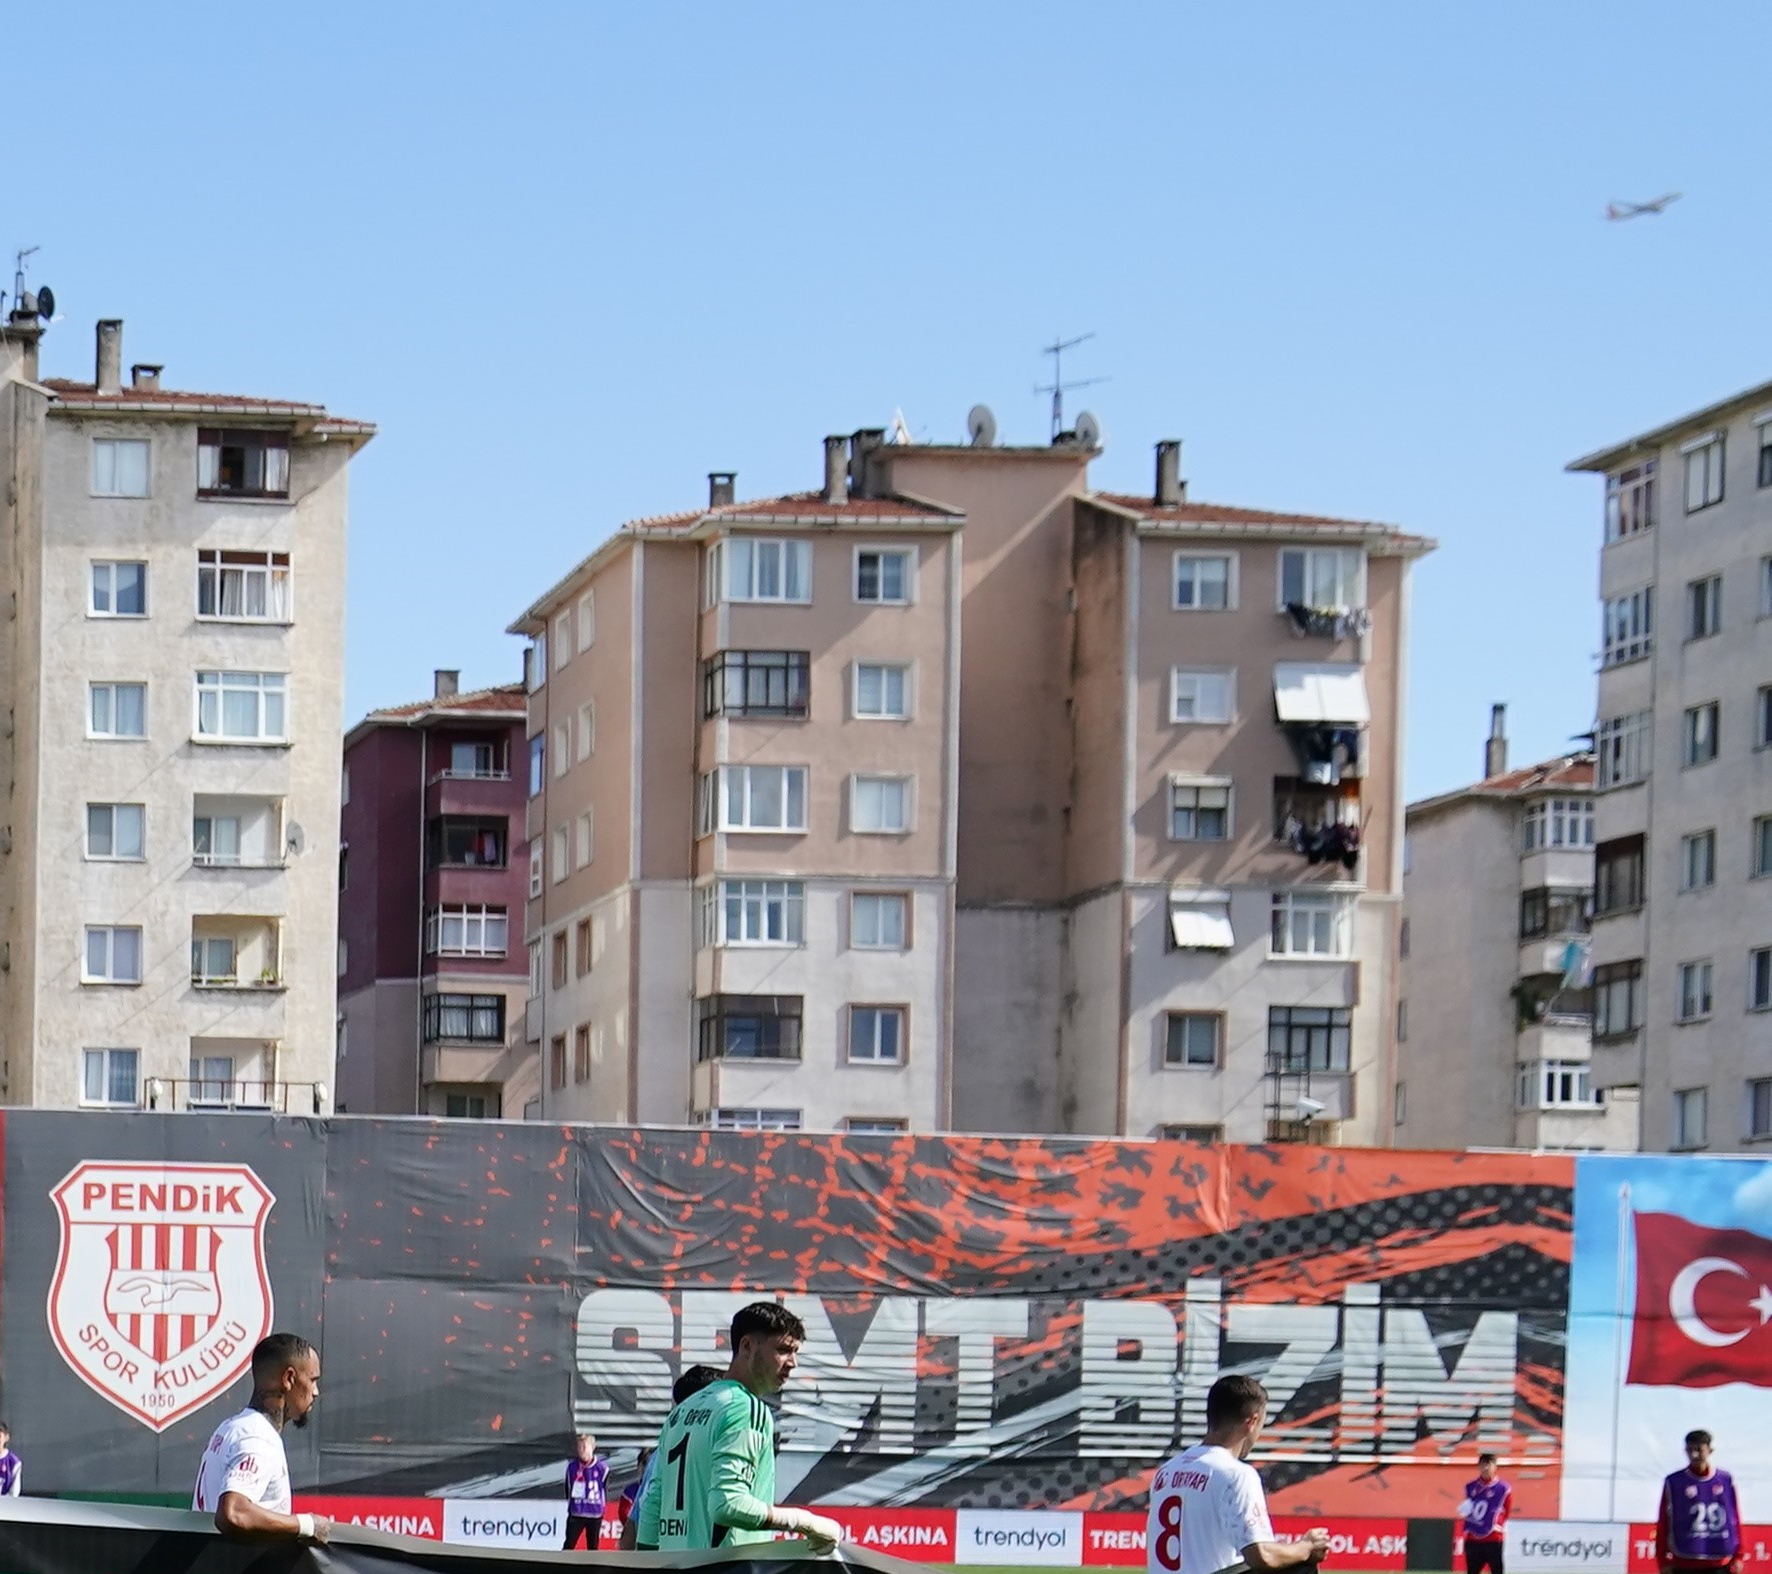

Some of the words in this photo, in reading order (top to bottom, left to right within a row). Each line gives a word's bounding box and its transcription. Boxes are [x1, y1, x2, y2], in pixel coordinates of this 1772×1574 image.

[78, 1324, 139, 1385] SPOR
[153, 1320, 248, 1391] KULÜBÜ
[140, 1394, 176, 1408] 1950
[667, 1431, 691, 1512] 1
[461, 1516, 557, 1540] trendyol
[1688, 1501, 1727, 1532] 29
[862, 1524, 949, 1548] AŞKINA
[973, 1525, 1067, 1551] trendyol
[1155, 1494, 1183, 1572] 8
[1520, 1537, 1613, 1562] trendyol
